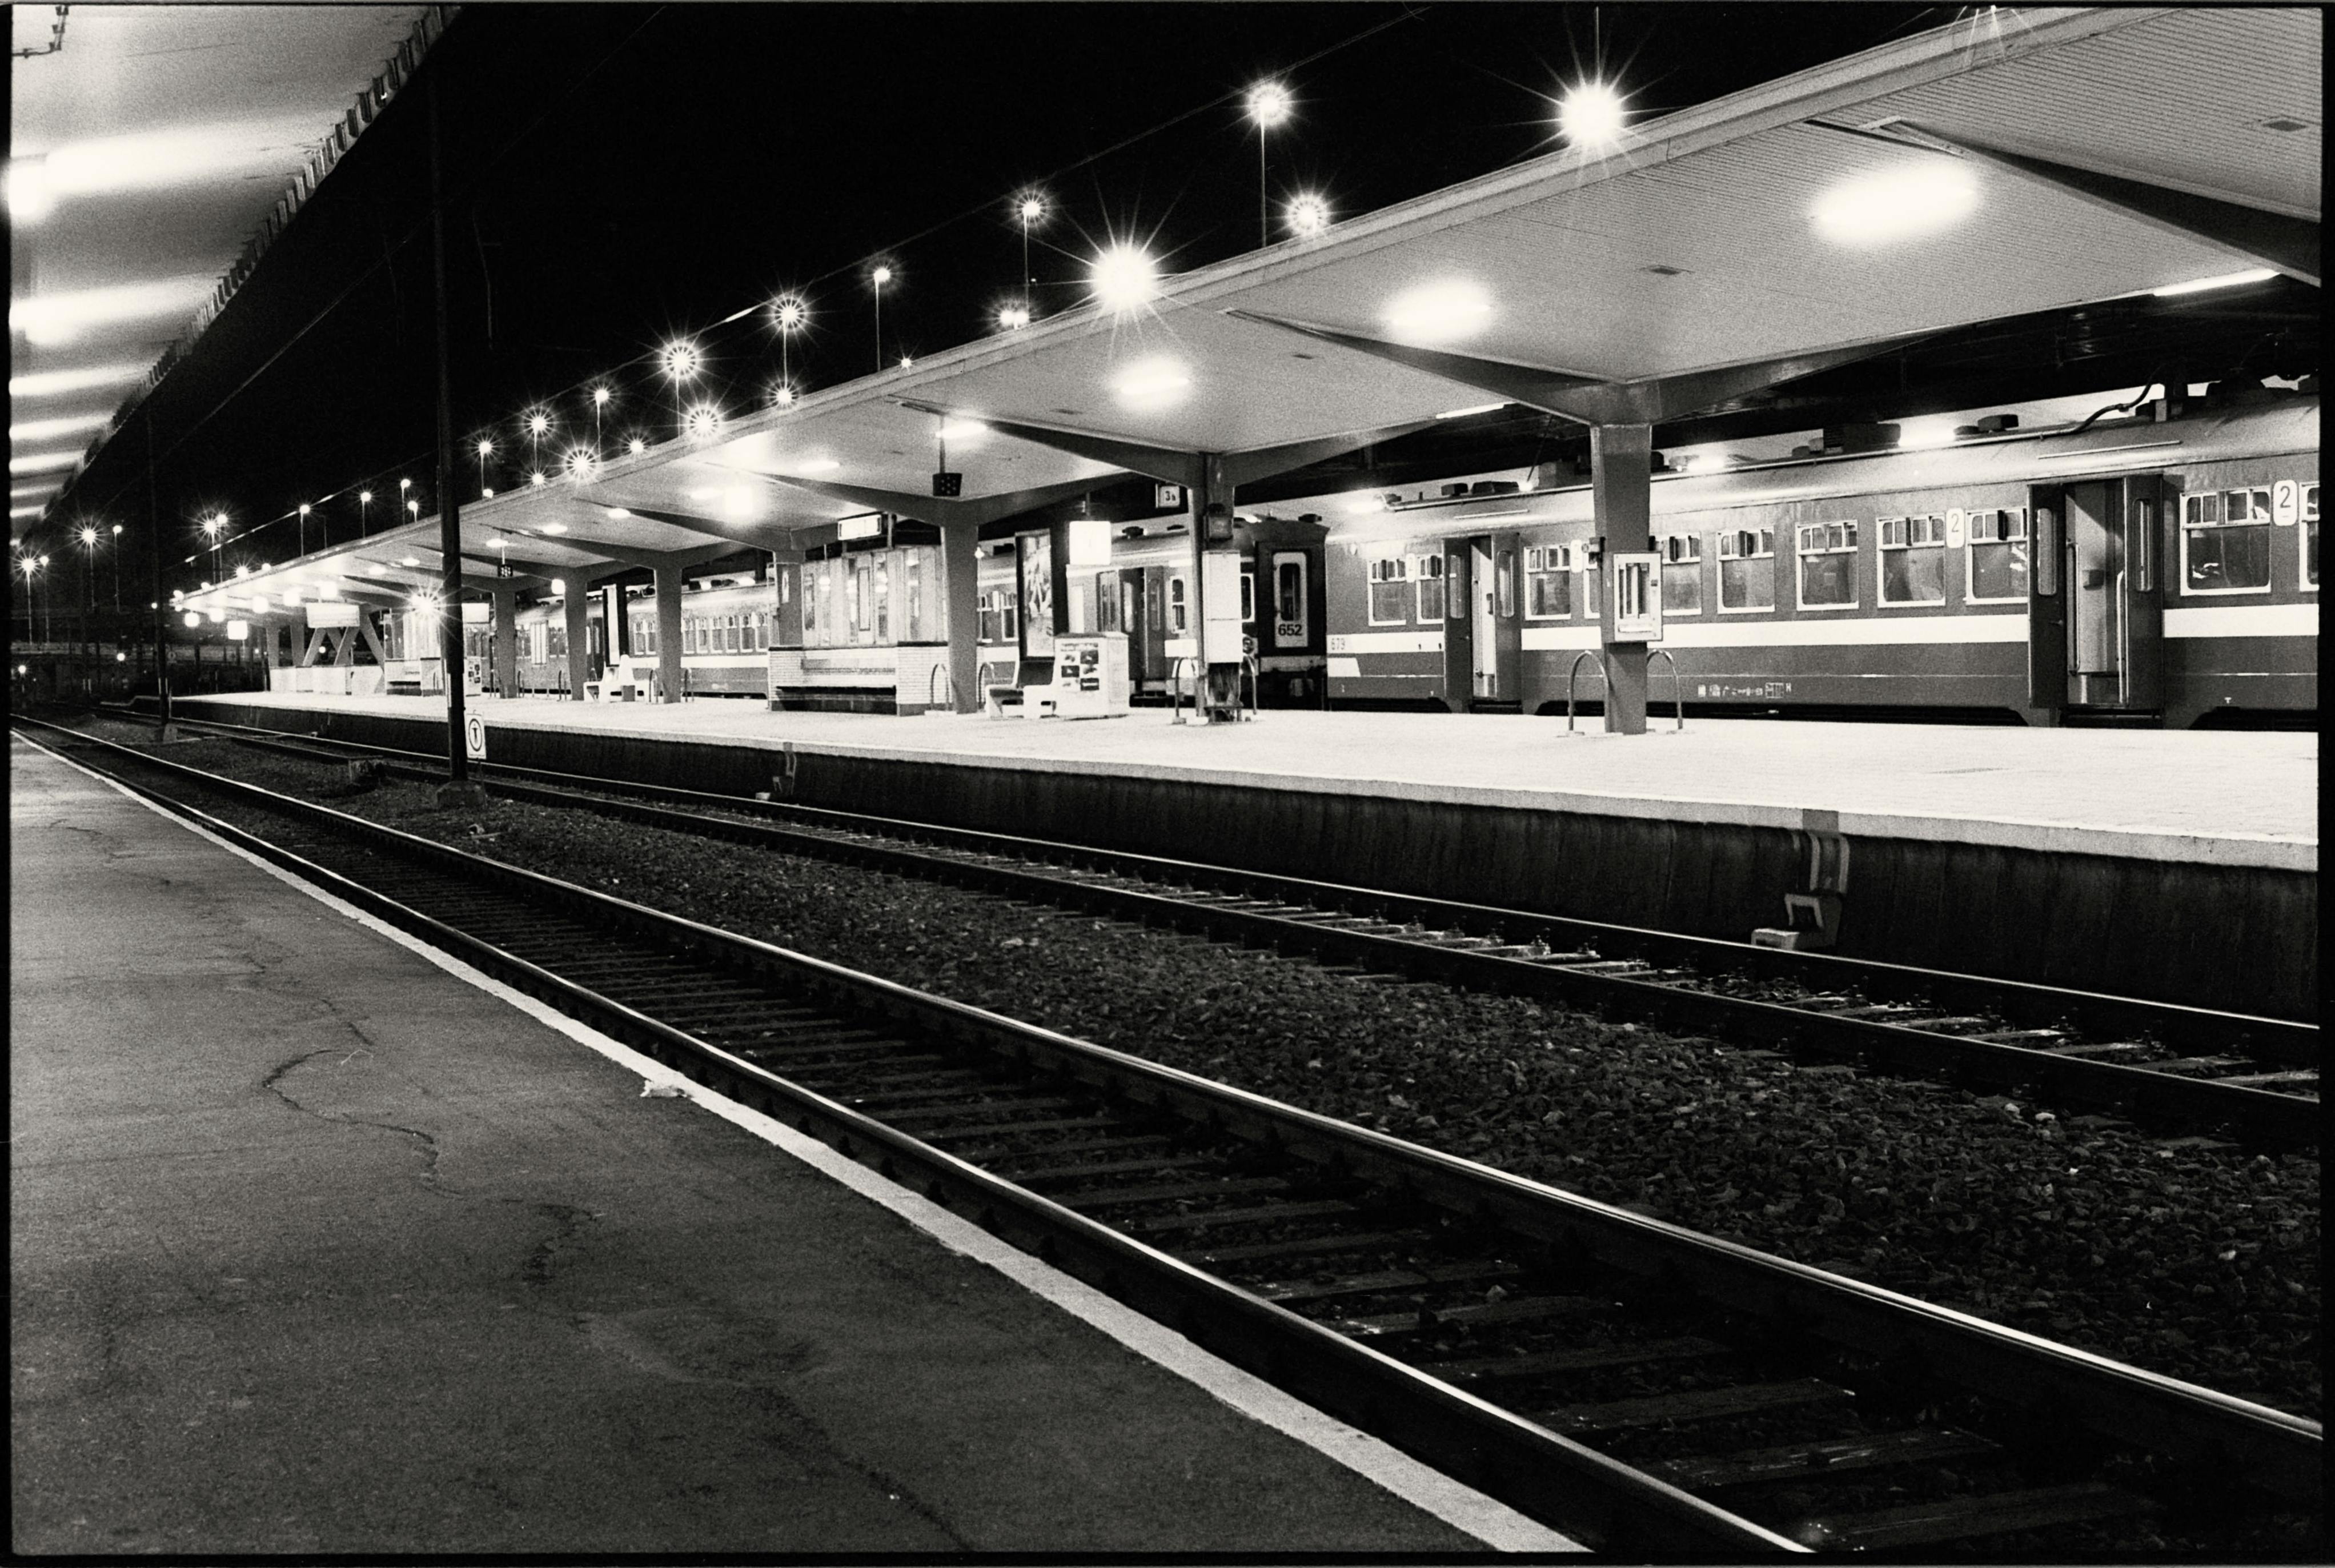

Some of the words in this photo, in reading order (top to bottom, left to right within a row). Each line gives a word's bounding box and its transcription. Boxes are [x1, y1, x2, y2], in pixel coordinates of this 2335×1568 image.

[2280, 485, 2291, 508] 2
[1951, 513, 1959, 532] 2
[1278, 623, 1303, 636] 652
